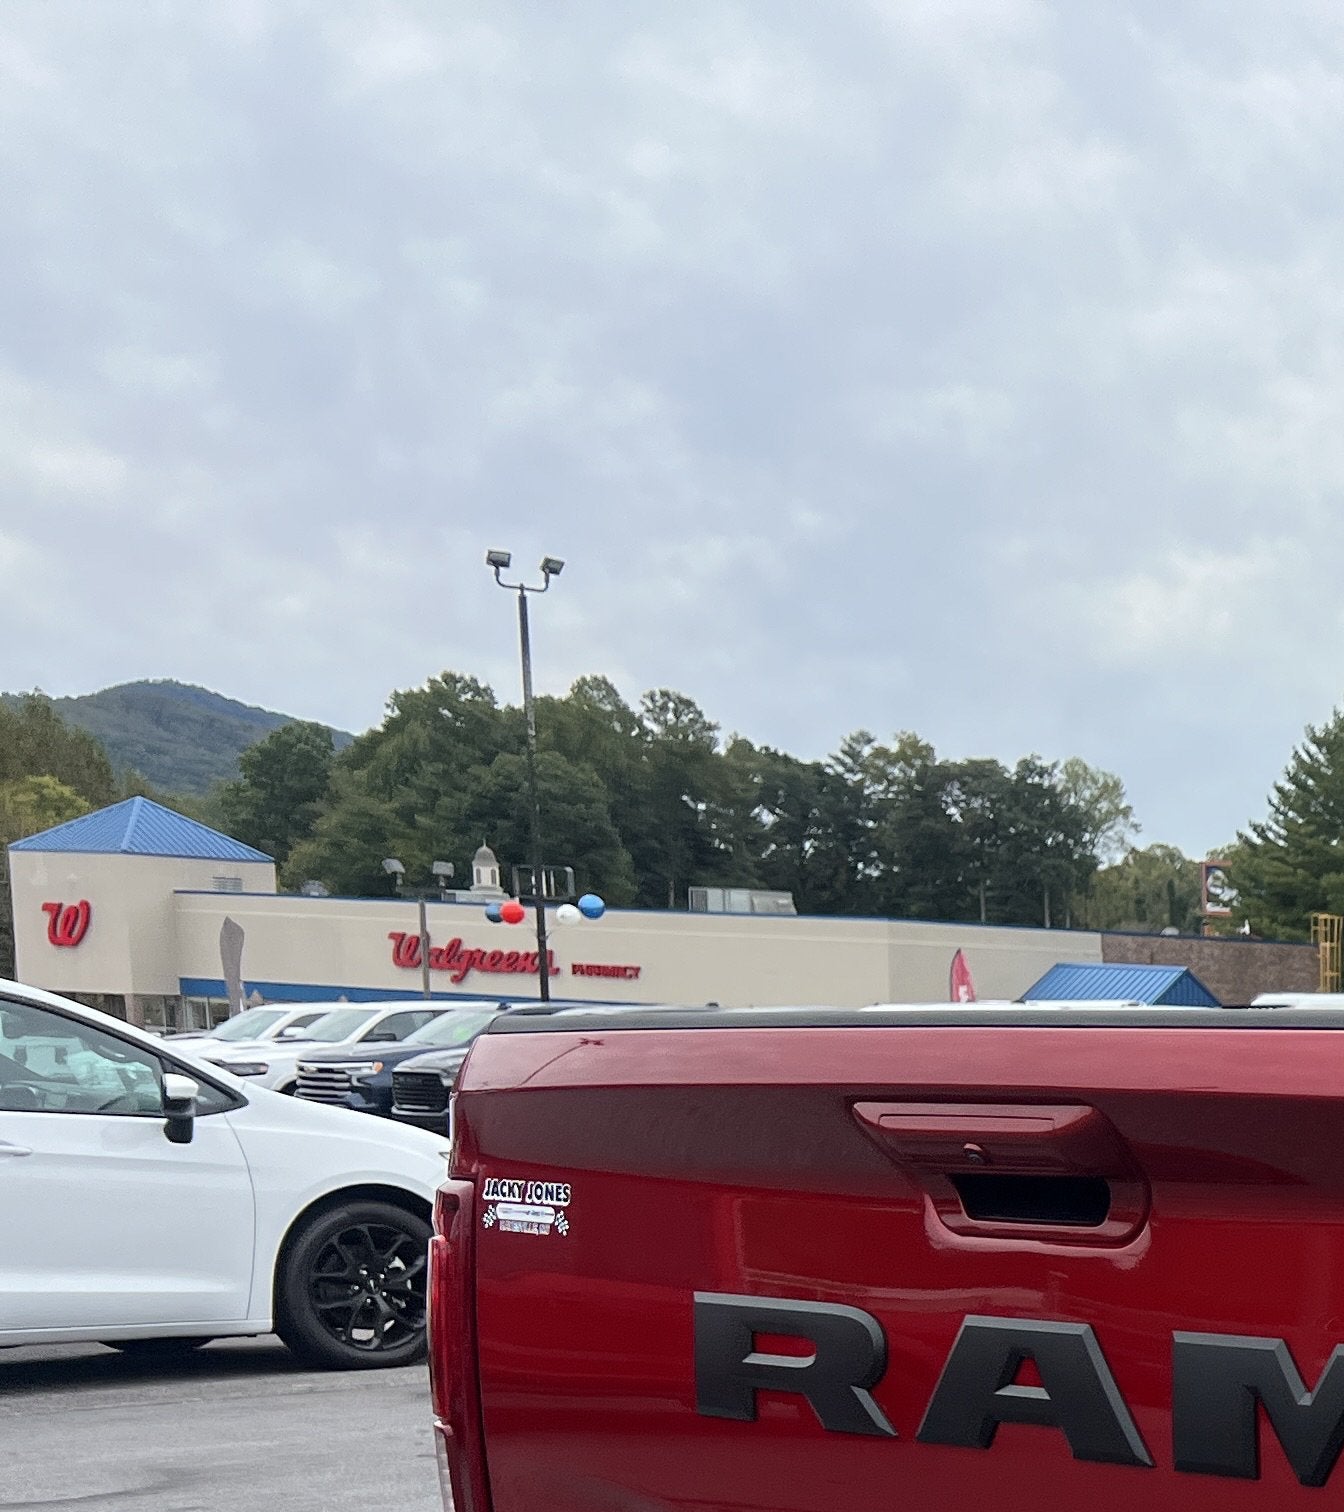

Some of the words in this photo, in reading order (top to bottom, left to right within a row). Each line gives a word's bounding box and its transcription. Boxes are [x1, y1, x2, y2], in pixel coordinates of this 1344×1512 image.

[42, 899, 90, 947] W
[484, 1179, 525, 1200] JACKY
[526, 1181, 571, 1204] JONES
